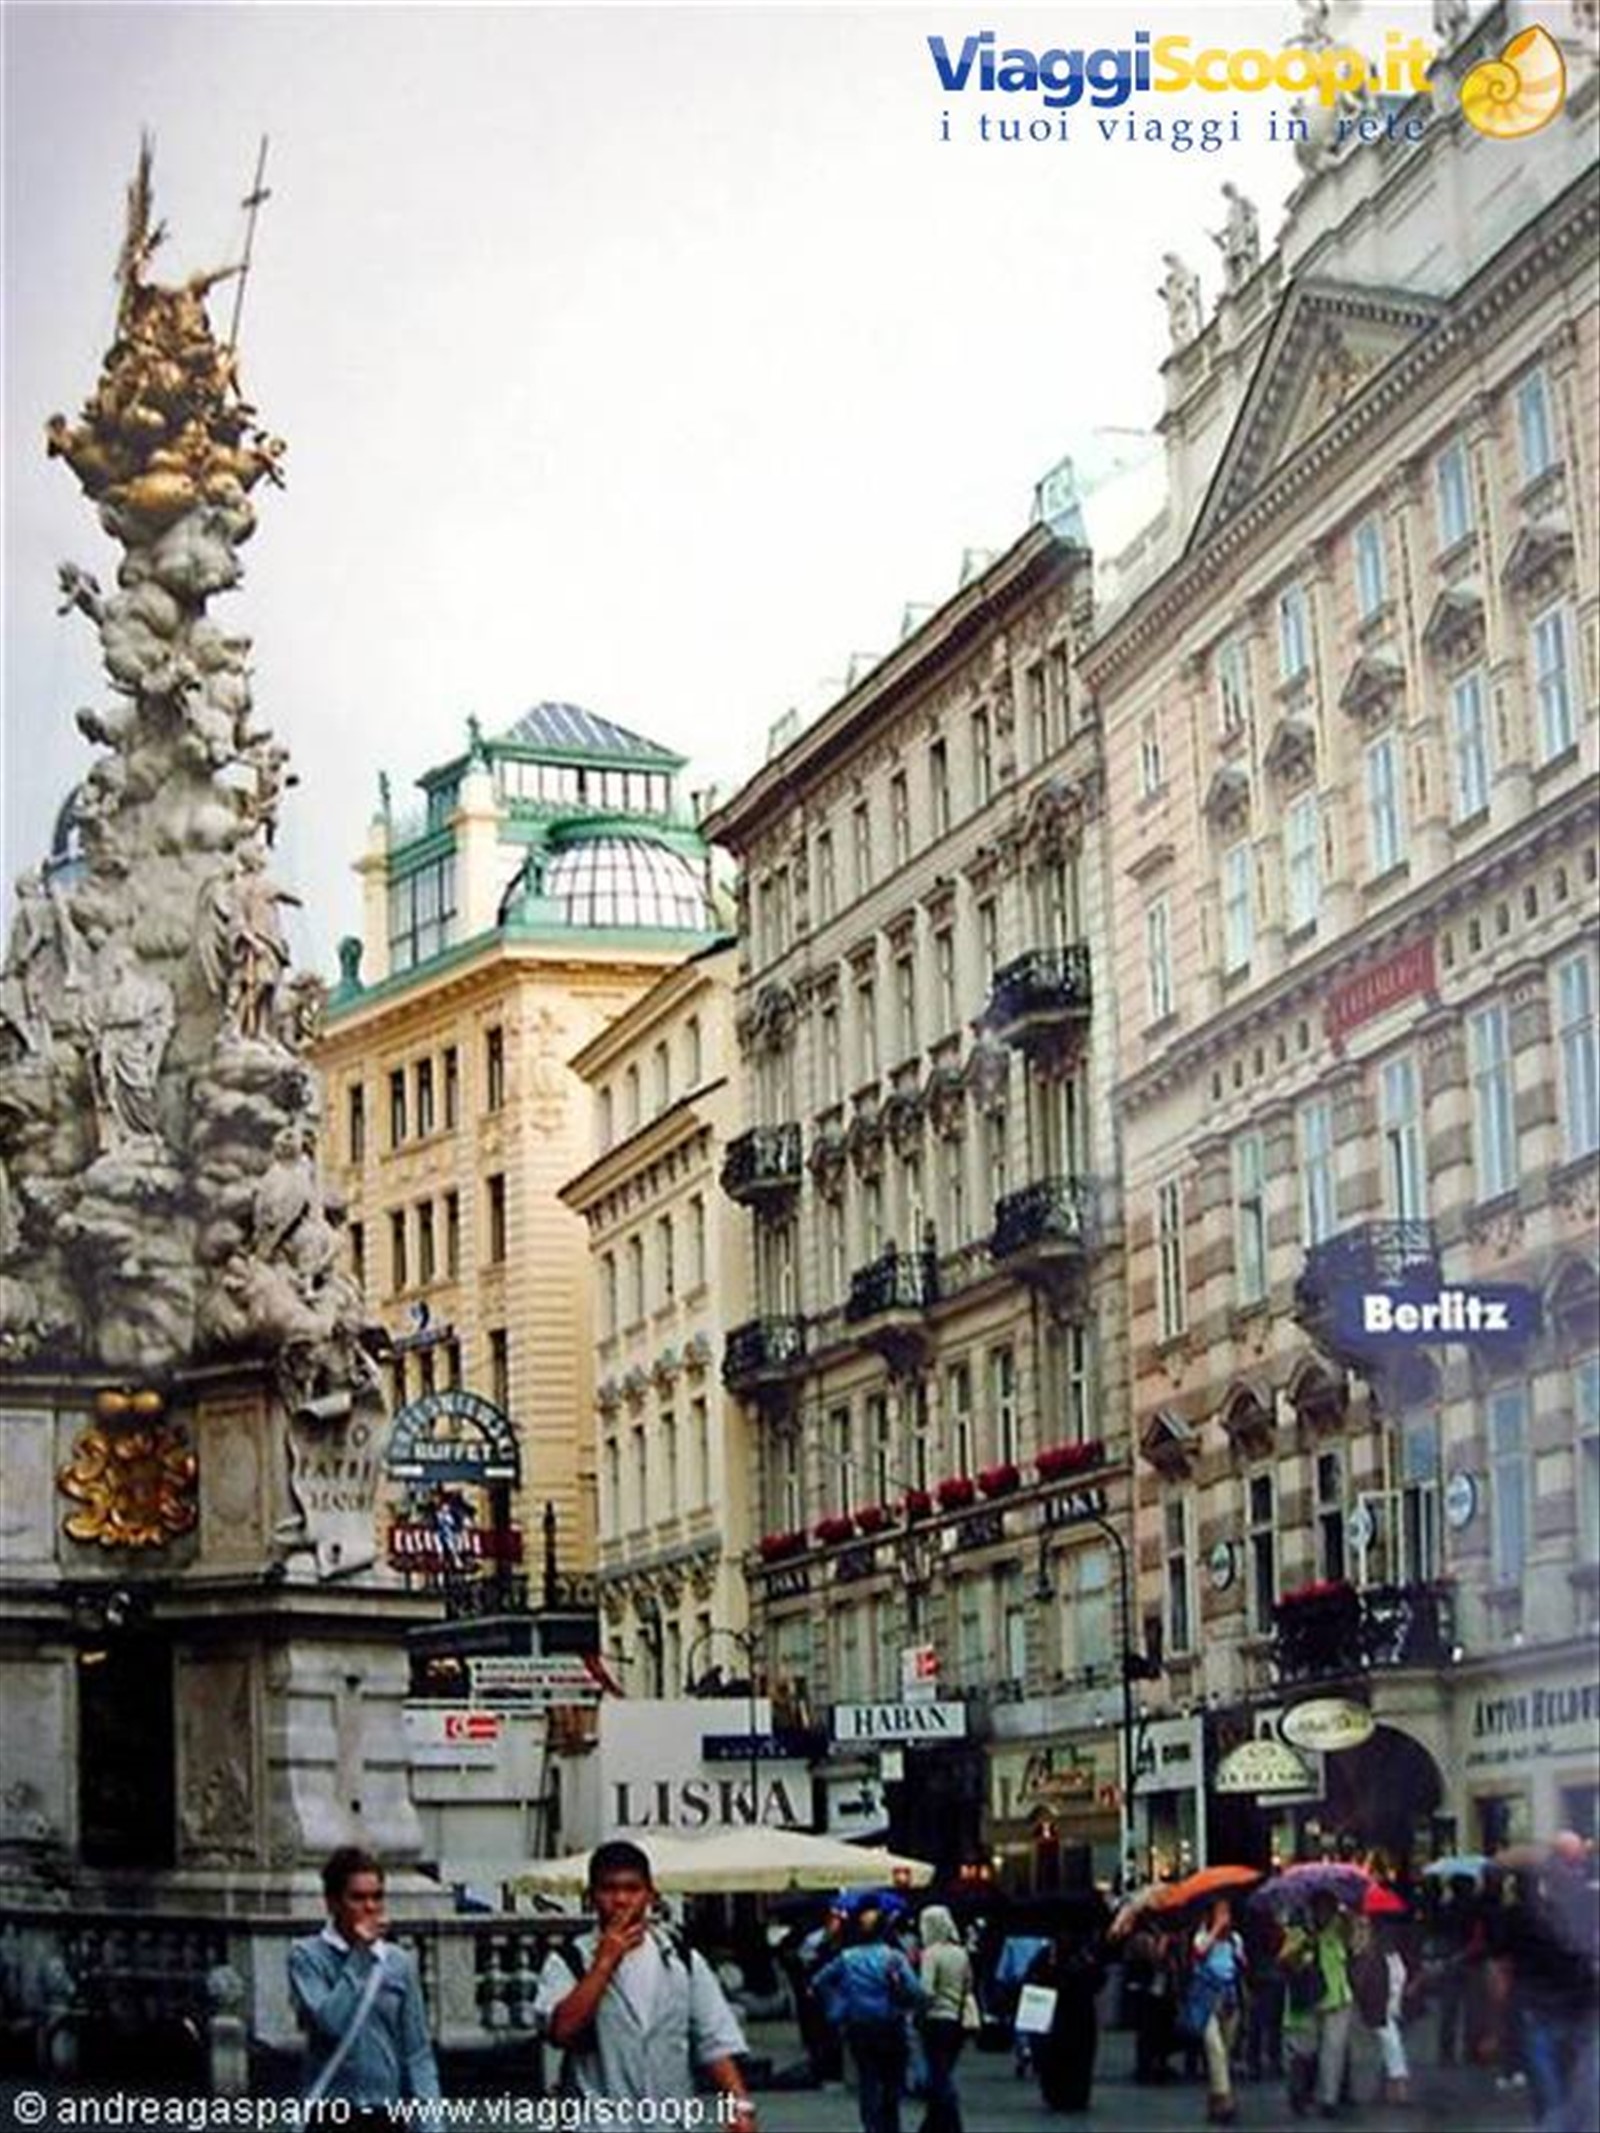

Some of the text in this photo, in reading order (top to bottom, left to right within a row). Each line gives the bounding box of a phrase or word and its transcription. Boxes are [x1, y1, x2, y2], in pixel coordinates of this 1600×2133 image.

[1363, 1291, 1509, 1333] Berlitz
[414, 1441, 494, 1461] BUFFET
[854, 1704, 954, 1737] HABAN
[612, 1778, 799, 1828] LISKA
